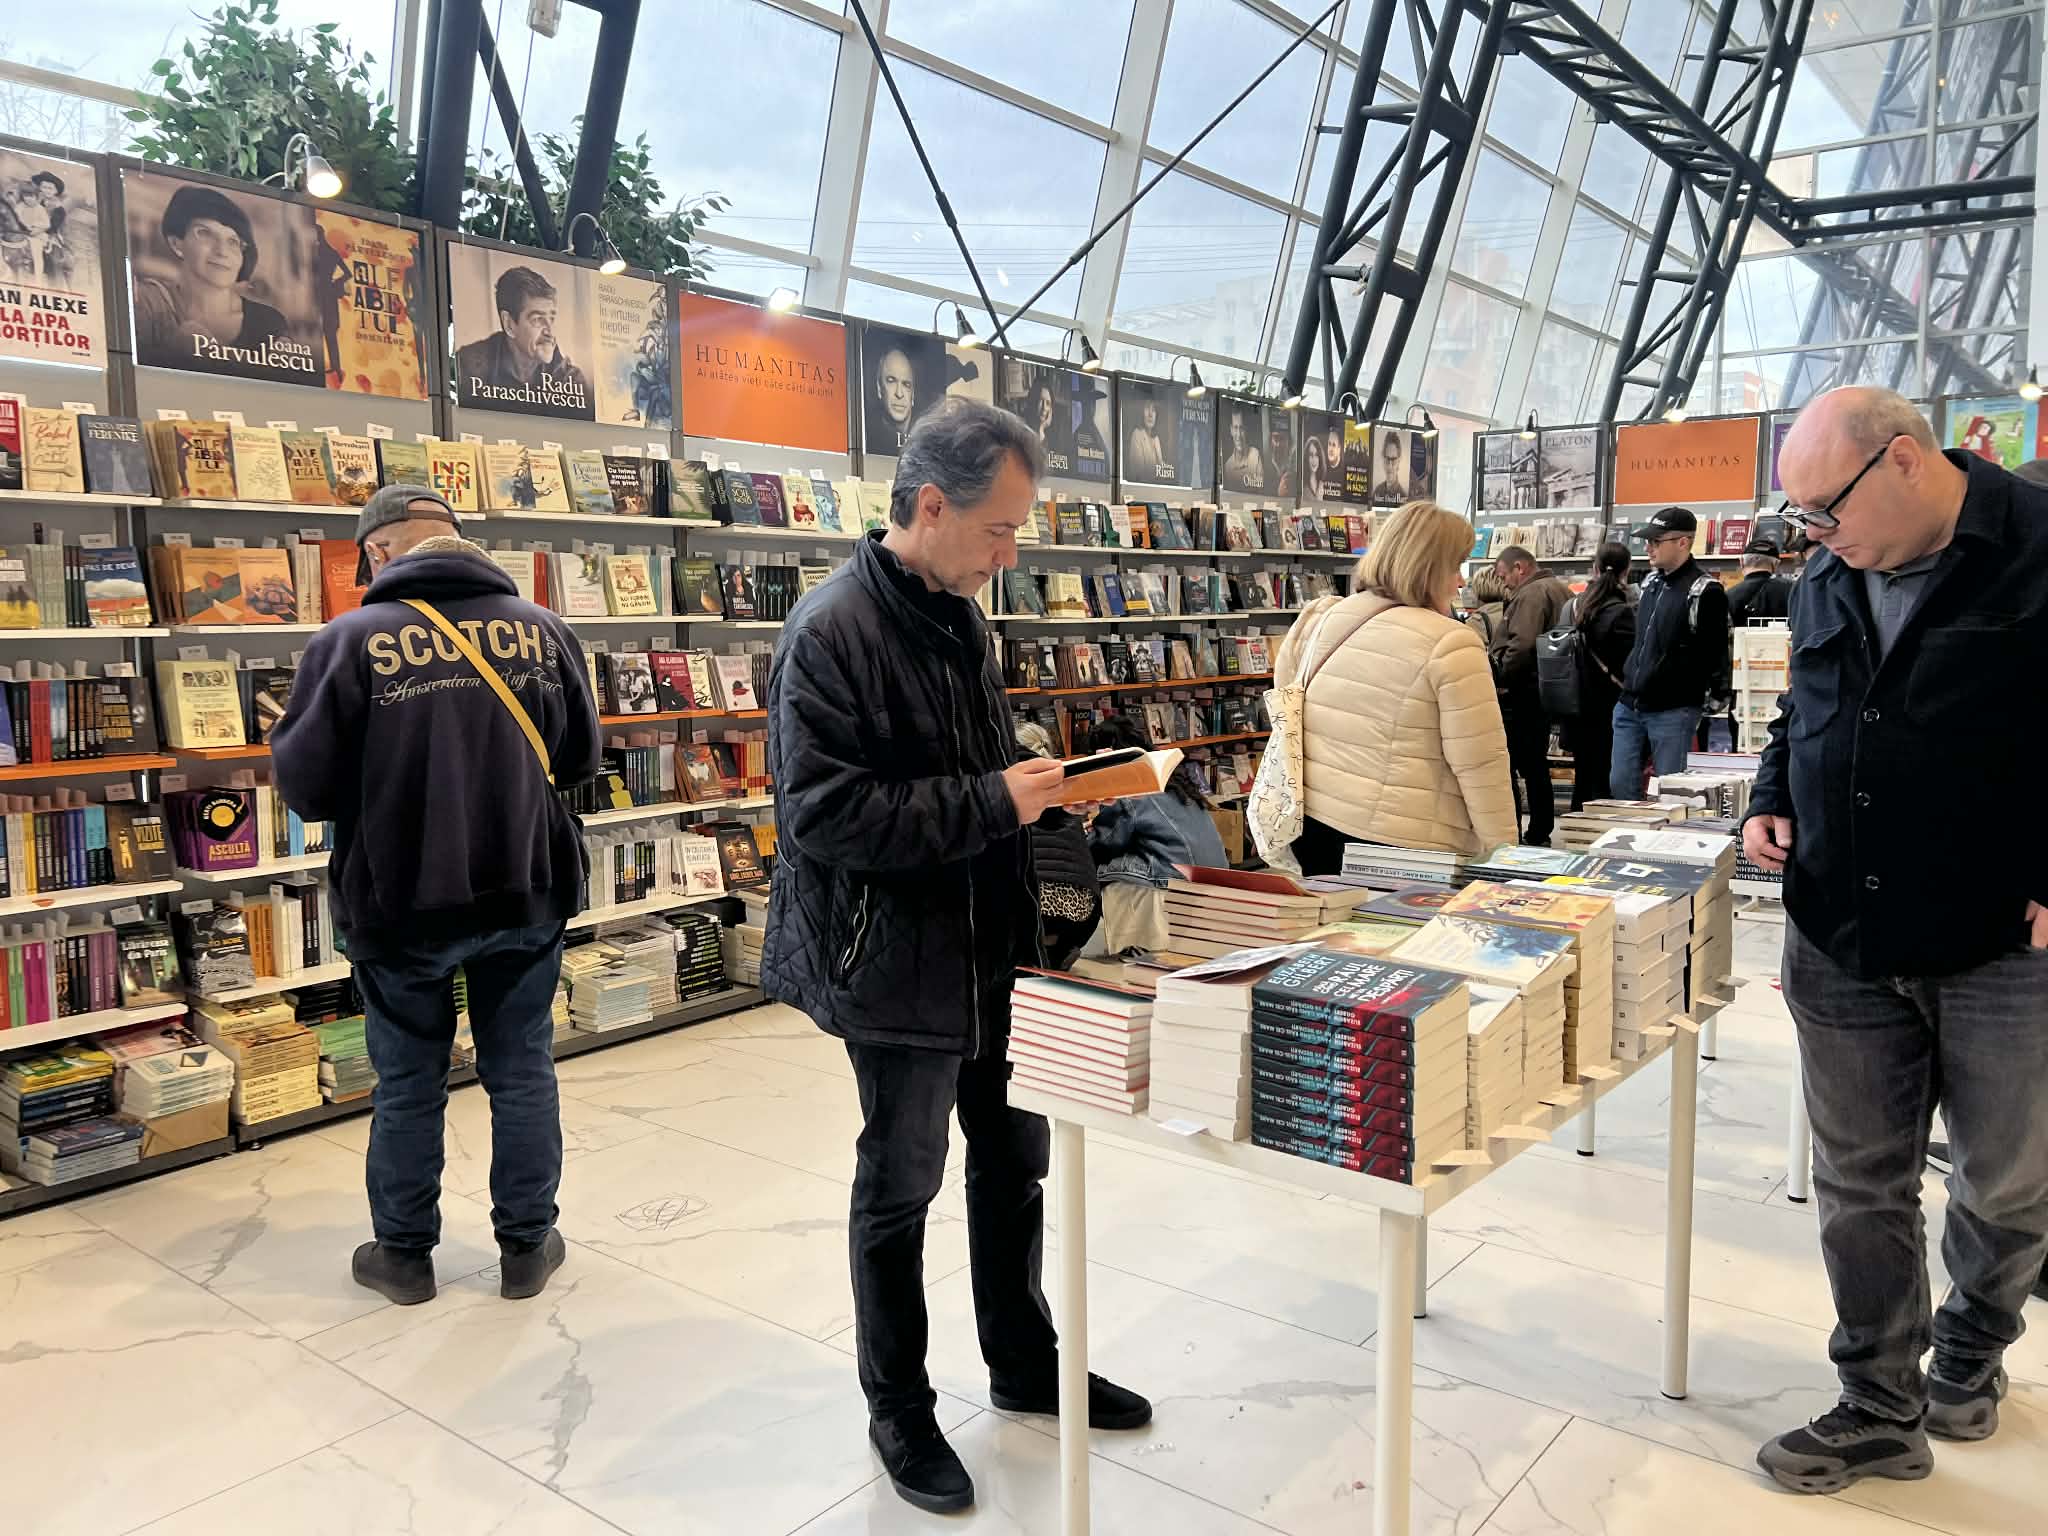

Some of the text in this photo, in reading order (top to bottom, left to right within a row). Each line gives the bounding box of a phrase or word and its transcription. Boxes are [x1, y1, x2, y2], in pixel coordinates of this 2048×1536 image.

[30, 294, 88, 315] ALEXE
[32, 312, 70, 331] APA
[0, 324, 91, 350] ORȚILOR
[268, 334, 312, 356] Ioana
[192, 333, 316, 372] Pârvulescu
[696, 344, 835, 384] HUMANITAS
[470, 376, 587, 409] Paraschivescu
[541, 372, 585, 396] Radu
[1544, 435, 1592, 448] PLATON
[1631, 455, 1742, 472] HUMANITAS
[368, 619, 543, 676] SCOTCH
[209, 841, 251, 857] ASCULTĂ
[1267, 953, 1321, 985] ELIZABETH
[1283, 956, 1337, 988] GILBERT
[1332, 961, 1368, 986] RĂUL
[1352, 964, 1386, 988] MARE
